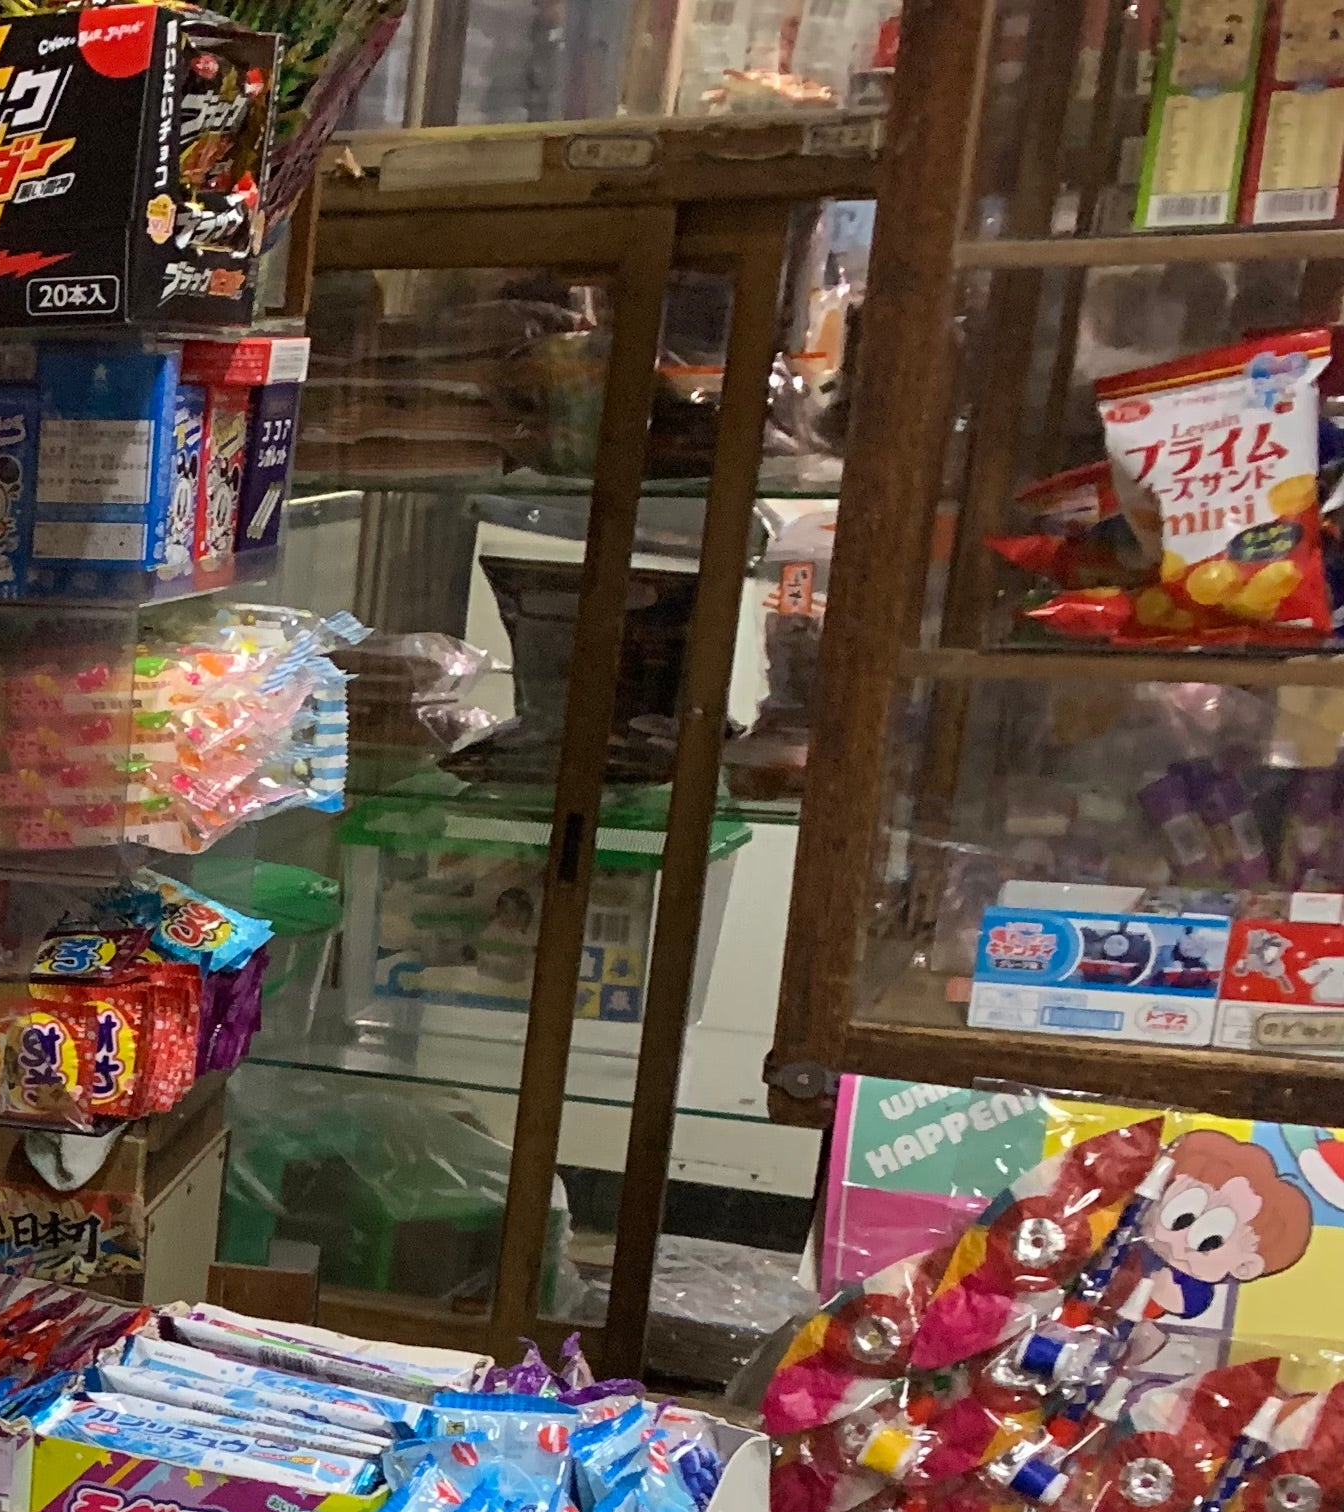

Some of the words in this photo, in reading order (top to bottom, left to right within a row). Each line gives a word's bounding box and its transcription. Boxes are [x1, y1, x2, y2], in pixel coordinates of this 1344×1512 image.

[38, 282, 107, 308] 20本入
[260, 418, 293, 443] ココア
[1124, 422, 1290, 483] プライム
[1157, 463, 1277, 501] ーズサンド
[11, 1212, 102, 1264] 日本刀
